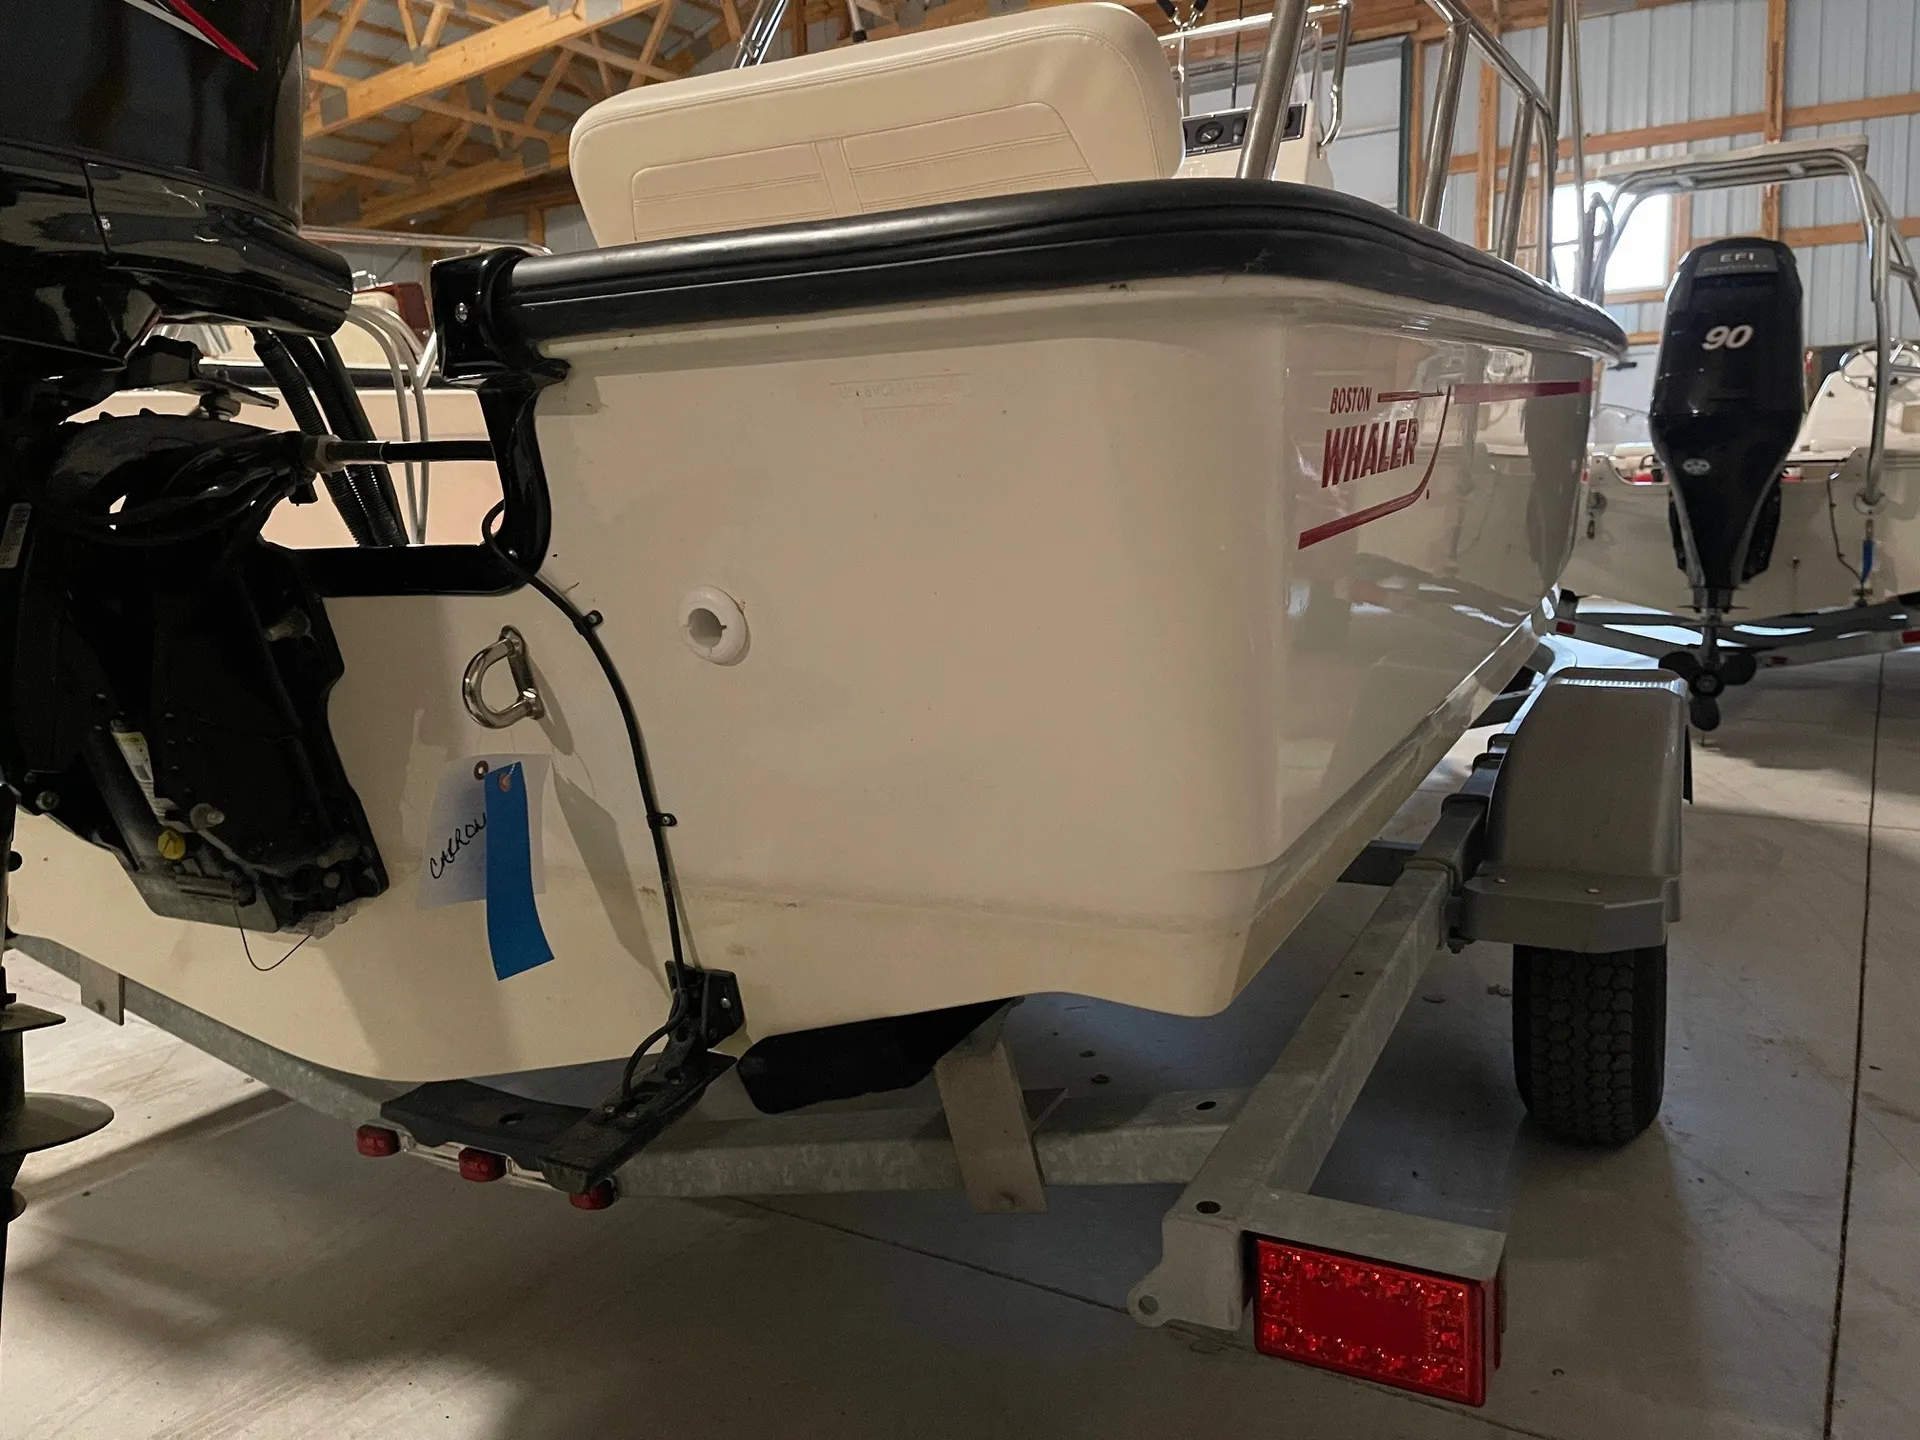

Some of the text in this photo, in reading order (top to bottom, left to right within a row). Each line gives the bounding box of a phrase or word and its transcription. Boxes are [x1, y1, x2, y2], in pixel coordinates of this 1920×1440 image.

[1719, 252, 1755, 263] EFI
[1701, 323, 1755, 351] 90
[1330, 386, 1373, 415] BOSTON
[1321, 417, 1420, 489] WHALER
